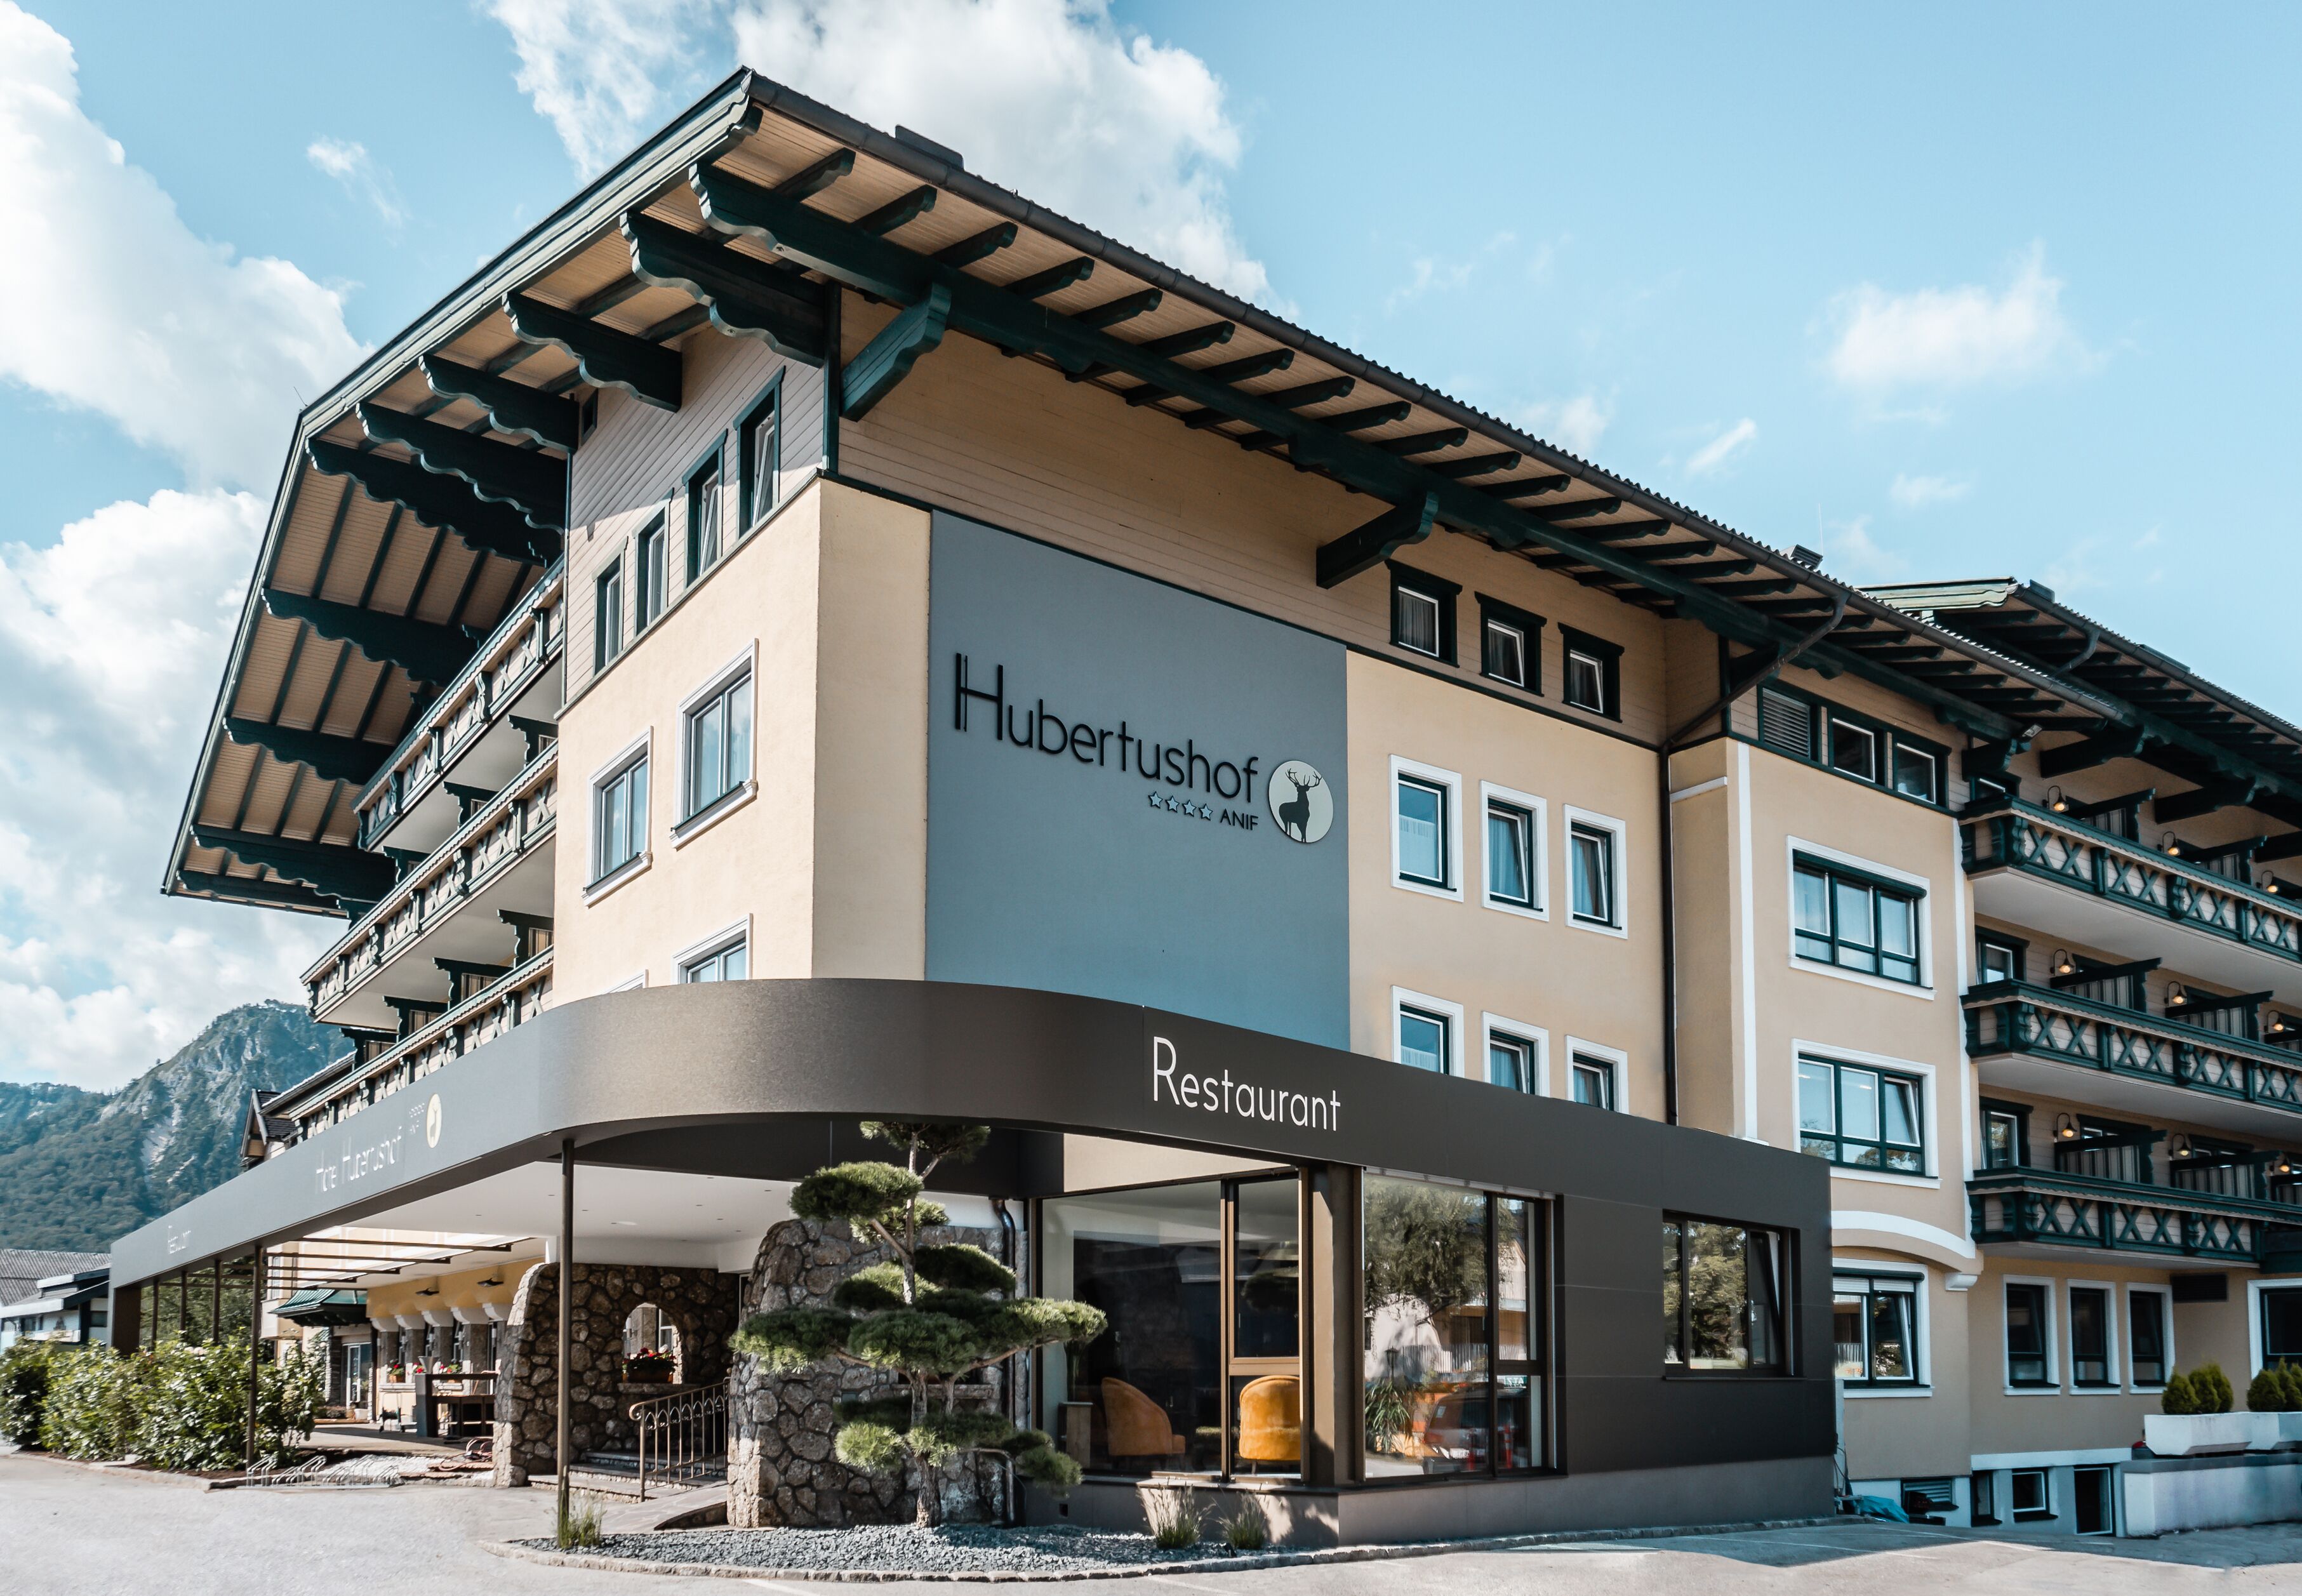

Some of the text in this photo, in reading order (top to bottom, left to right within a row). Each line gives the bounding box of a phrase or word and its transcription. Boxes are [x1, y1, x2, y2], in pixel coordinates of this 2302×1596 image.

[954, 652, 1258, 803] Hubertushof
[1220, 808, 1259, 831] ANIF
[1153, 1035, 1341, 1131] Restaurant
